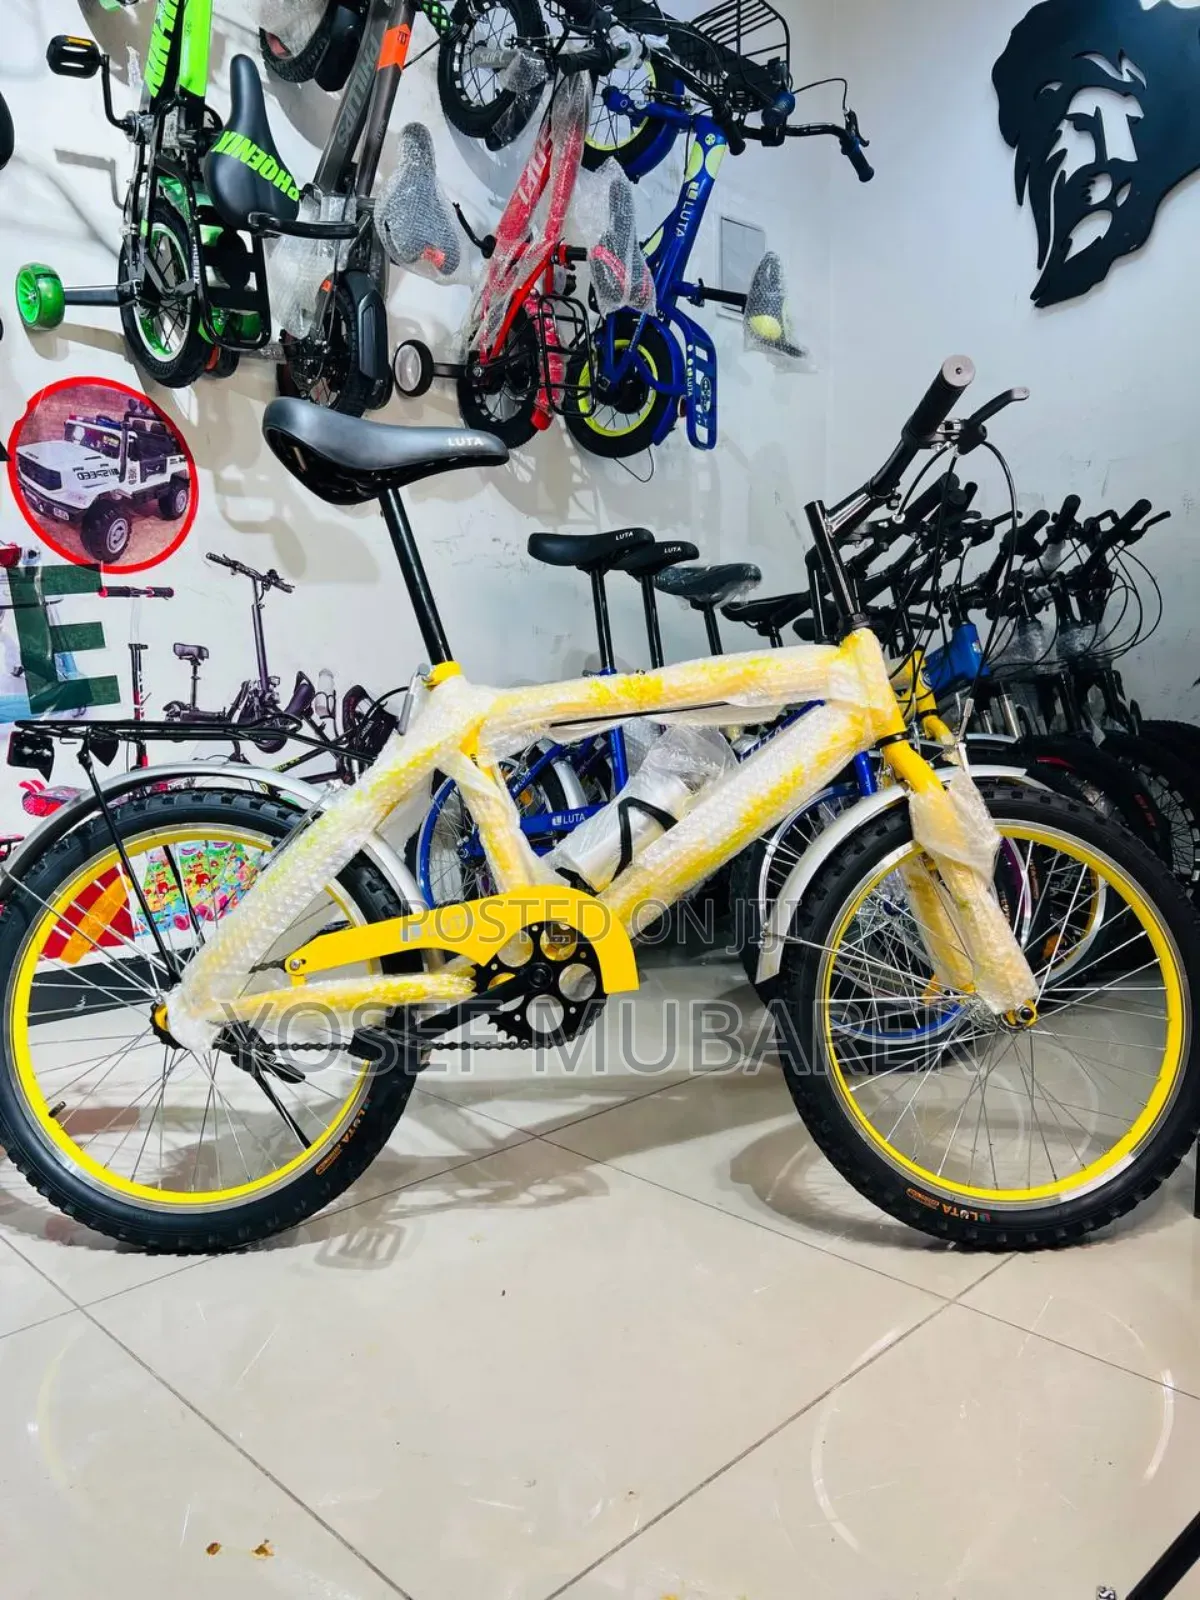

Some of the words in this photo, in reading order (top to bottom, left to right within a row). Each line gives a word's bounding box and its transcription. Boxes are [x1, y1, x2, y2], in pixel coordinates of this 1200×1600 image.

[210, 131, 300, 202] PHOENIX
[675, 200, 695, 237] LUTA
[447, 436, 485, 447] LUTA
[615, 530, 634, 541] LUTA
[663, 545, 682, 554] LUTA
[563, 813, 586, 825] LUTA
[942, 1203, 979, 1221] LUTA
